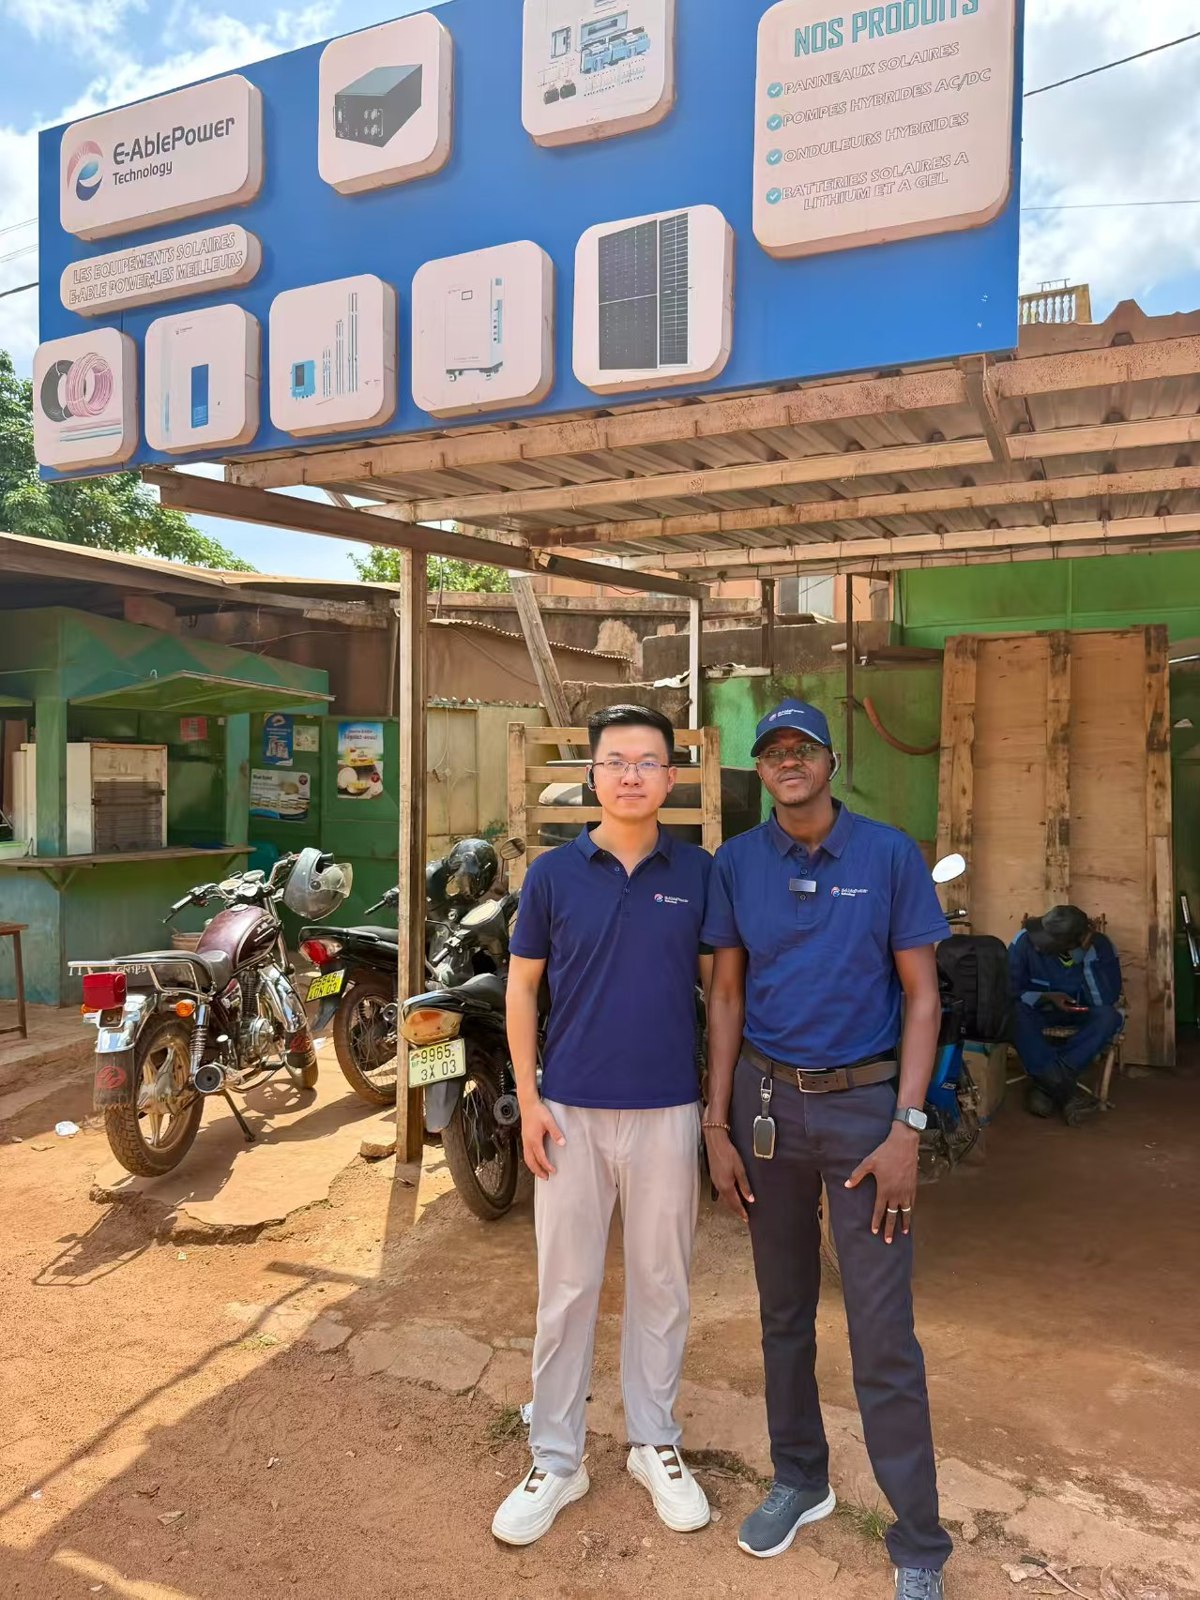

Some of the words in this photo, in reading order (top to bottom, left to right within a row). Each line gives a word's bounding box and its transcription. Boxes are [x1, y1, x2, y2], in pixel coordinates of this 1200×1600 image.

[794, 17, 844, 57] NOS
[784, 62, 876, 95] PANNEAUX
[878, 41, 960, 73] SOLAIRES
[783, 101, 847, 127] POMPES
[850, 82, 932, 112] HYBRIDES
[935, 67, 992, 92] AC/DC
[113, 117, 235, 165] E-AblePower
[784, 131, 882, 162] ONDULEURS
[885, 112, 969, 142] HYBRIDES
[112, 161, 173, 186] Technology
[782, 172, 868, 200] BATTERIES
[870, 155, 951, 182] SOLAIRES
[954, 152, 969, 166] A
[804, 186, 871, 211] LITHIUM
[874, 181, 896, 197] ET
[897, 179, 912, 193] A
[915, 172, 949, 189] GEL
[69, 281, 108, 305] E-ABLE
[175, 250, 243, 280] MEILLEURS
[73, 266, 92, 285] LES
[94, 246, 175, 280] EQUIPEMENTS
[176, 232, 236, 260] SOLAIRES
[421, 1044, 451, 1064] 9965
[421, 1064, 436, 1081] 3X
[442, 1059, 457, 1076] 03
